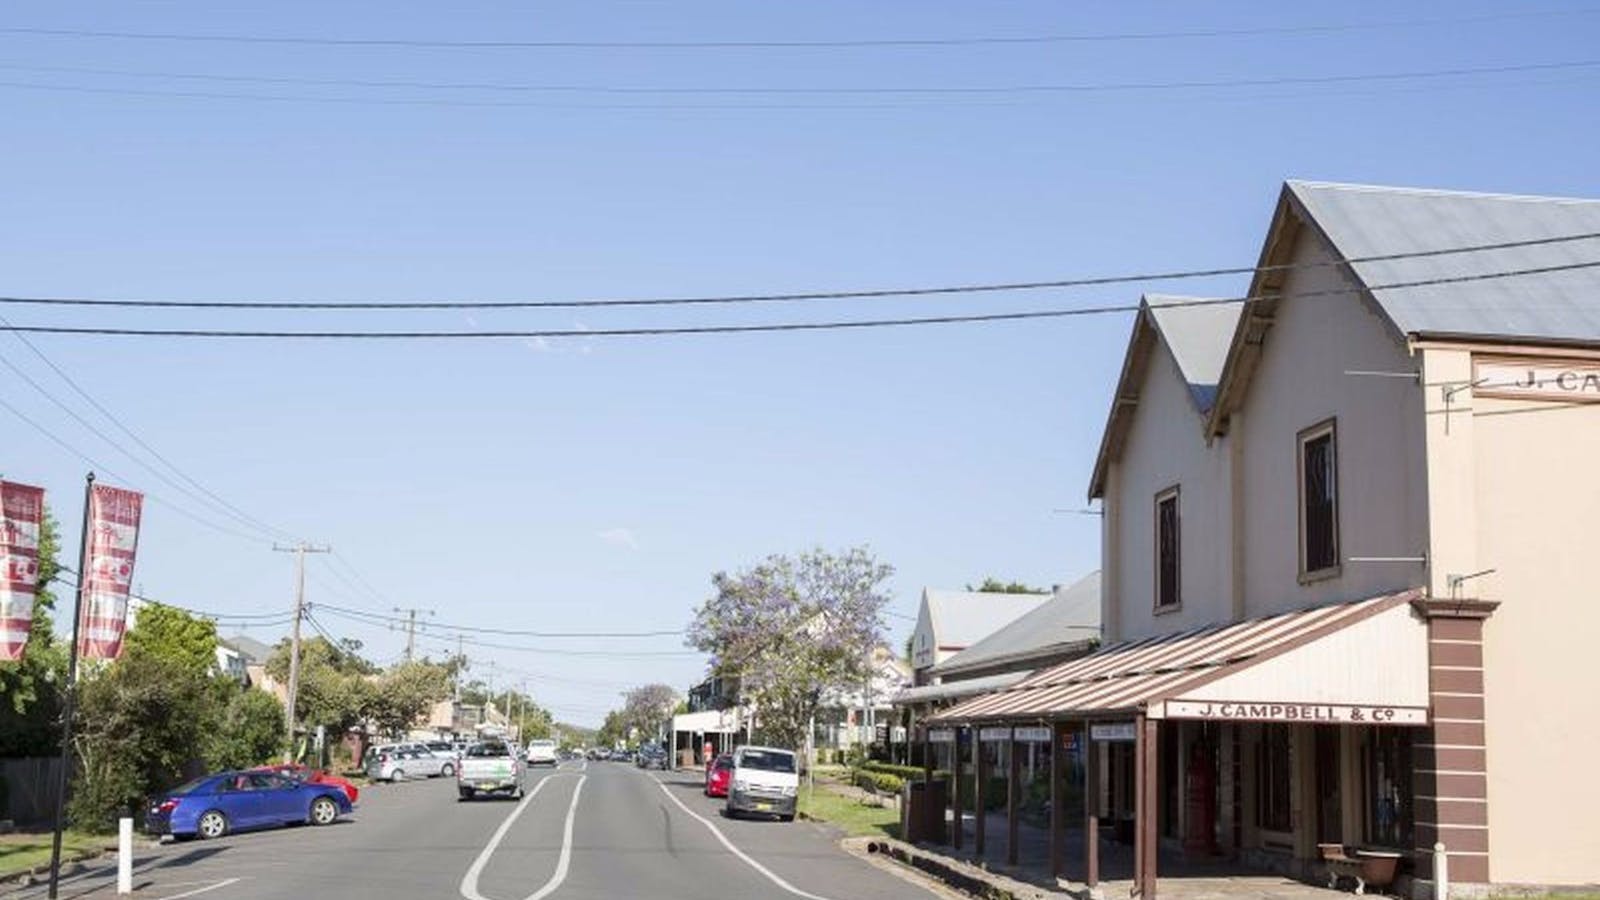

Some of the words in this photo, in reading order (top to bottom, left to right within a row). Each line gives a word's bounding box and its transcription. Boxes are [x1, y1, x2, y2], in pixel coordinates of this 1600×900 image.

[1515, 370, 1544, 389] J.
[1220, 703, 1340, 720] CAMPBELL
[1350, 706, 1365, 722] &
